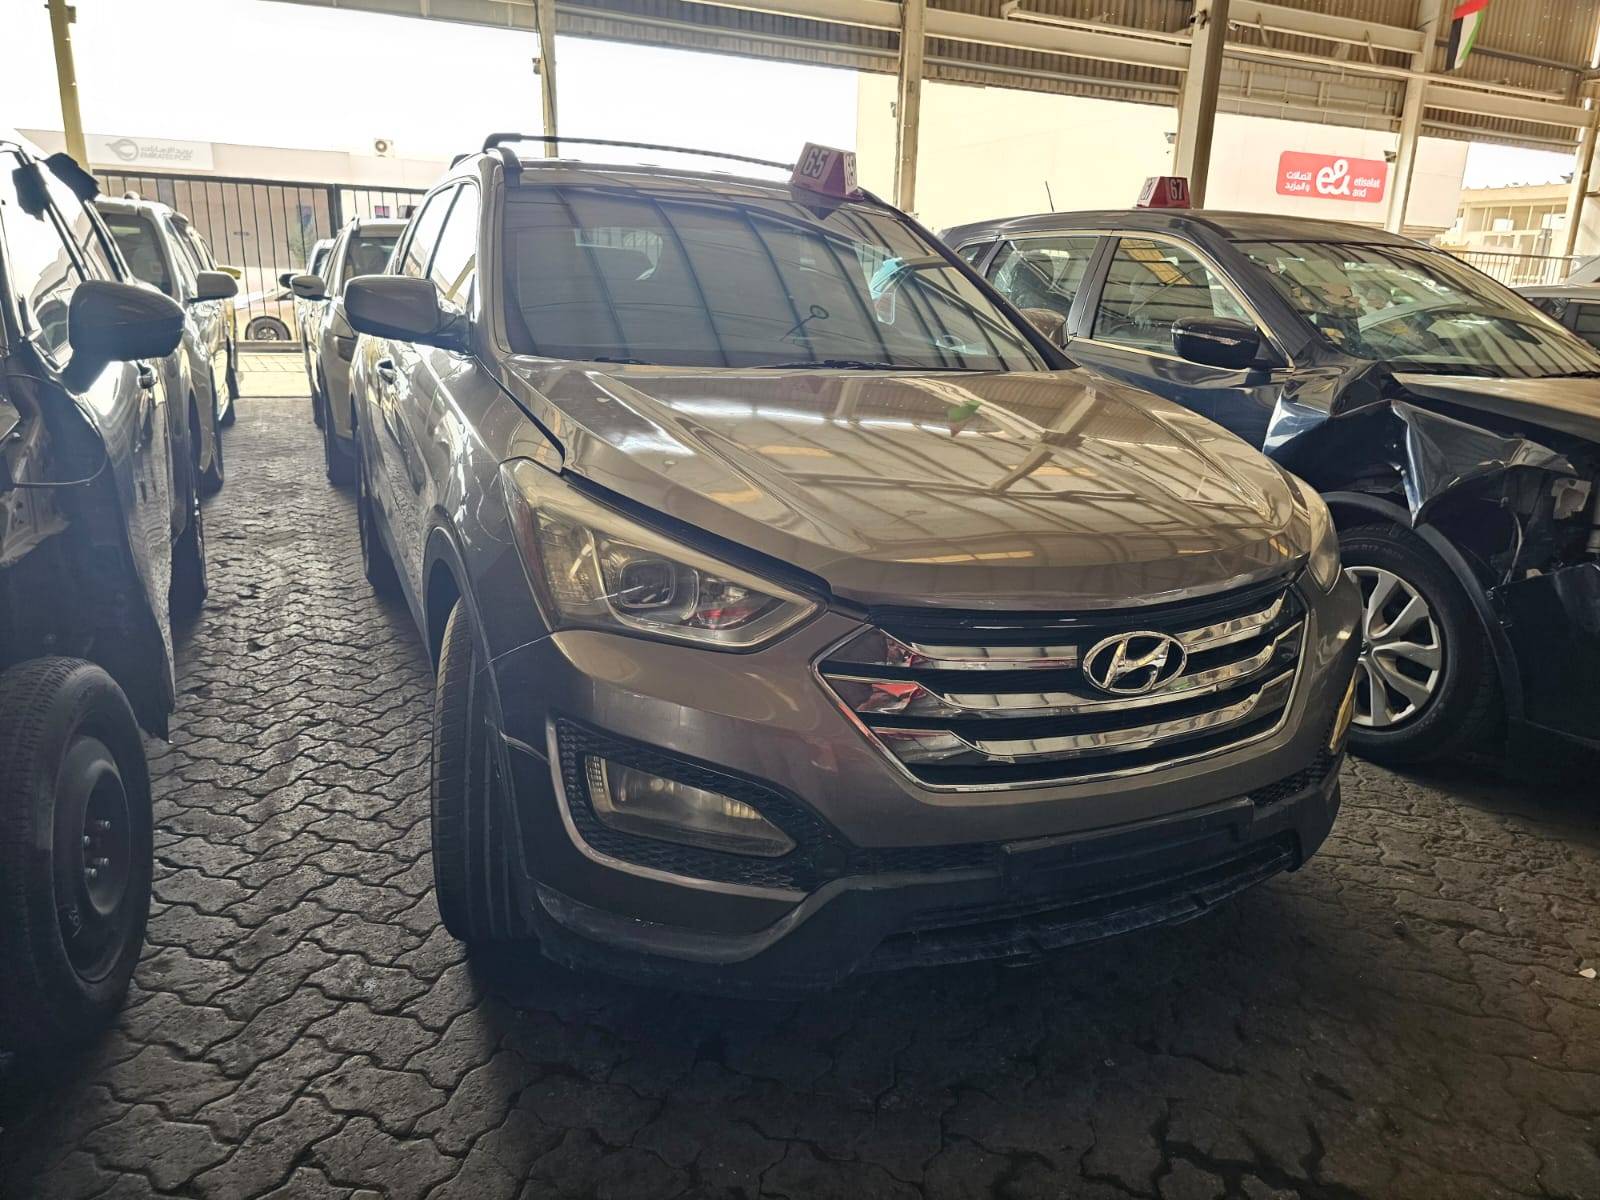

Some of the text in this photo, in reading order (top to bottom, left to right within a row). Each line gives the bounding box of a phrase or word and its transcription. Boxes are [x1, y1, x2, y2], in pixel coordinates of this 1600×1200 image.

[802, 147, 829, 178] 65
[1286, 171, 1312, 181] اتصالات
[1353, 177, 1381, 188] etisalat
[1170, 178, 1183, 200] 67
[1352, 188, 1368, 198] and
